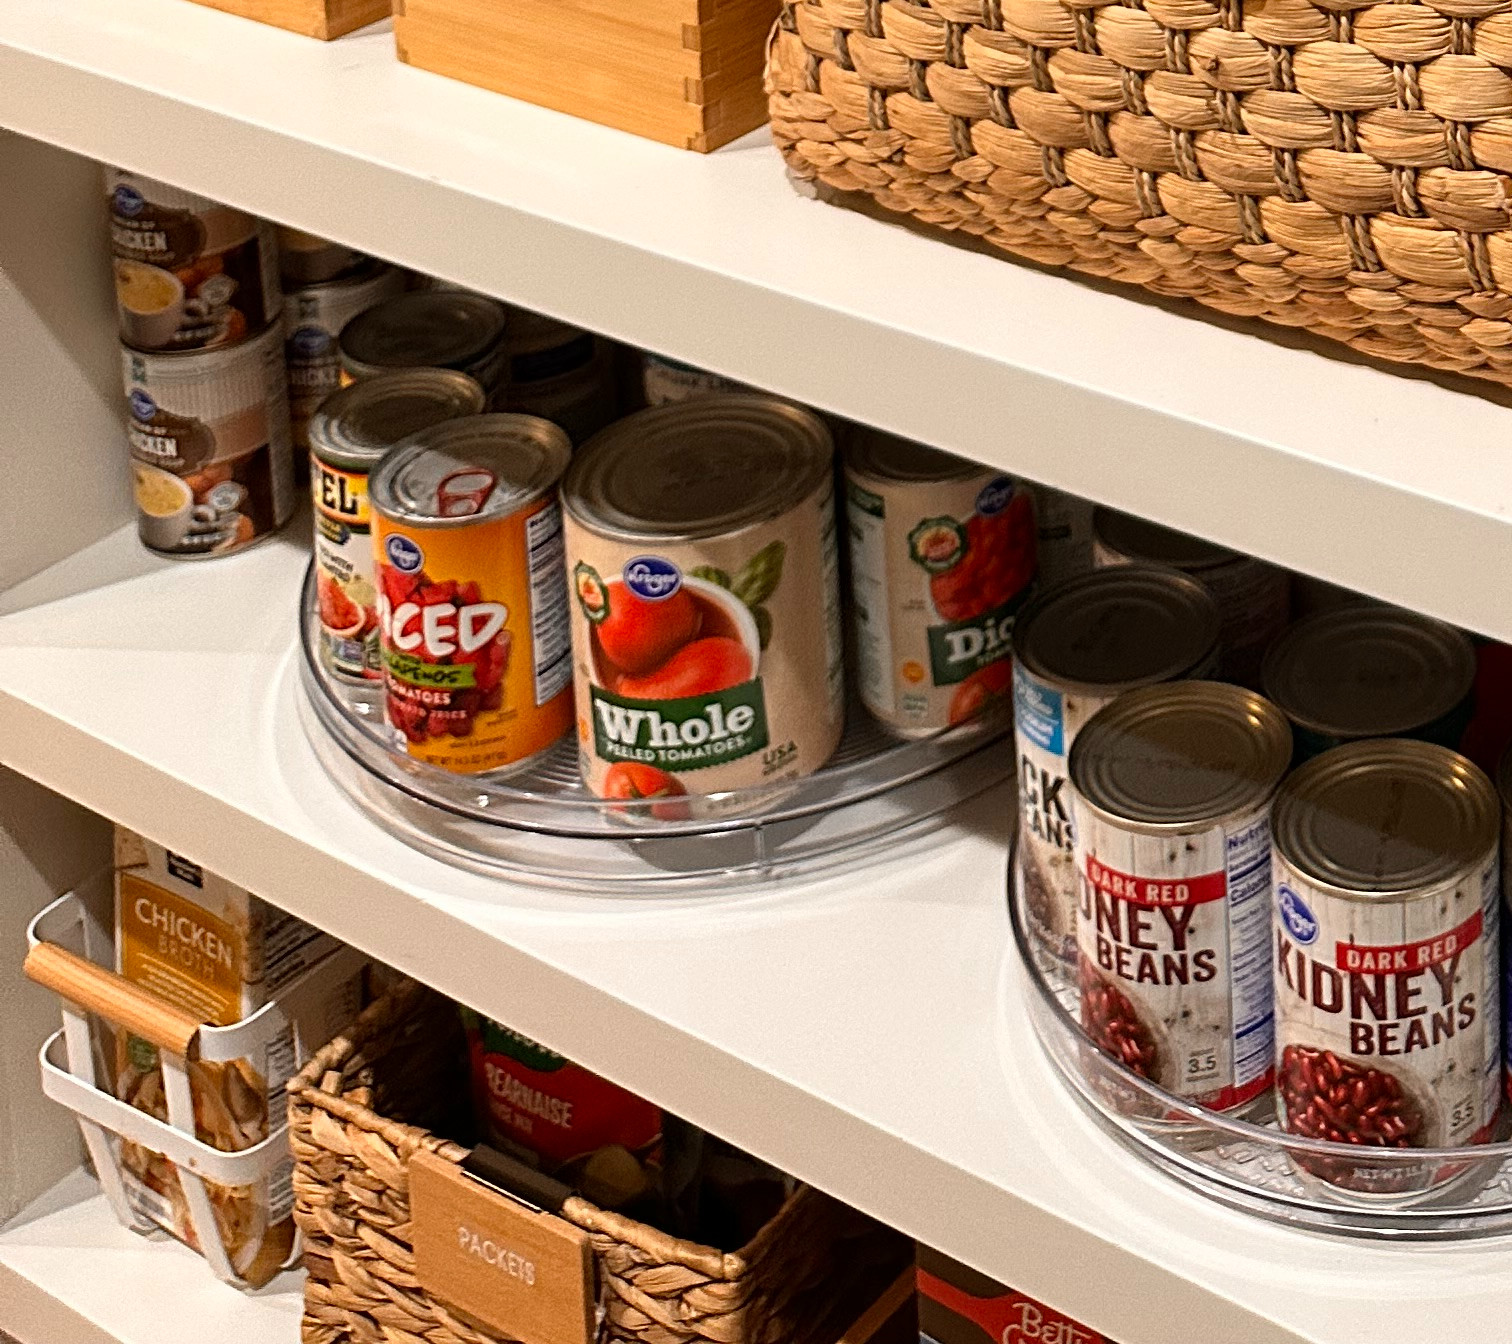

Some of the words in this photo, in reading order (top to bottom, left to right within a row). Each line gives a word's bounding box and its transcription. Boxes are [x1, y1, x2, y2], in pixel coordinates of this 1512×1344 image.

[593, 698, 756, 748] Whole
[606, 742, 656, 763] PEELED
[659, 734, 747, 763] TOMATOES
[1090, 862, 1138, 900] DARK
[1145, 883, 1190, 905] RED
[134, 898, 233, 971] CHICKEN
[1347, 948, 1408, 971] DARK
[1416, 934, 1458, 965] RED
[1096, 934, 1218, 986] BEANS
[1276, 928, 1462, 1021] KIDNEY
[1350, 992, 1476, 1056] BEANS
[1188, 1054, 1217, 1074] 3.5
[457, 1226, 536, 1286] PACKETS
[1012, 1301, 1093, 1344] Bett
